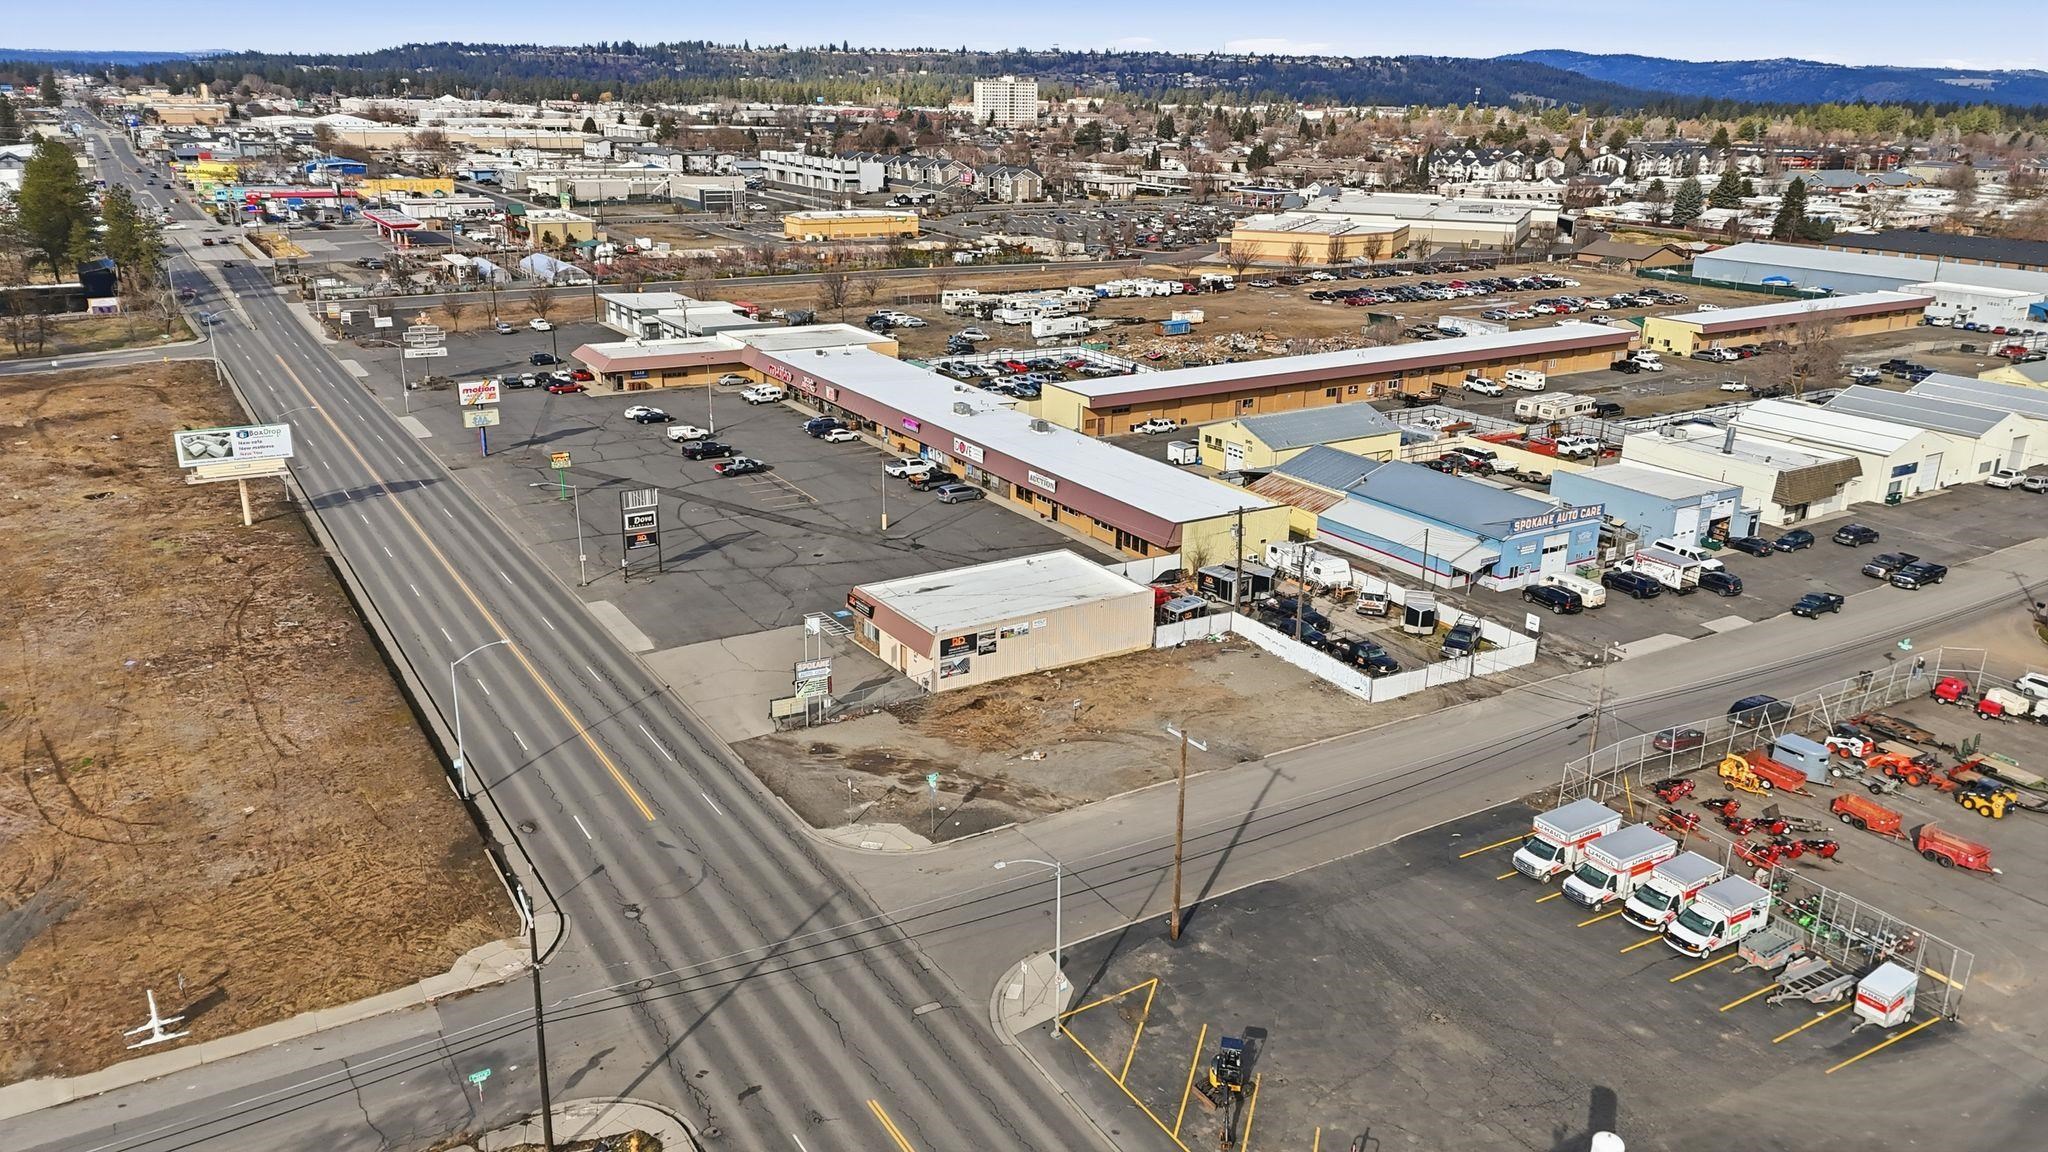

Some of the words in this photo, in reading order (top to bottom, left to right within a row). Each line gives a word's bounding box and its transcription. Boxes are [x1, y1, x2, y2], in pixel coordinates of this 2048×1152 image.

[462, 385, 496, 395] motion
[249, 428, 282, 438] BoxDrop
[1029, 474, 1055, 490] AUCTION
[1513, 514, 1555, 532] SPOKANE
[1556, 510, 1579, 523] AUTO
[1580, 505, 1602, 518] CARE
